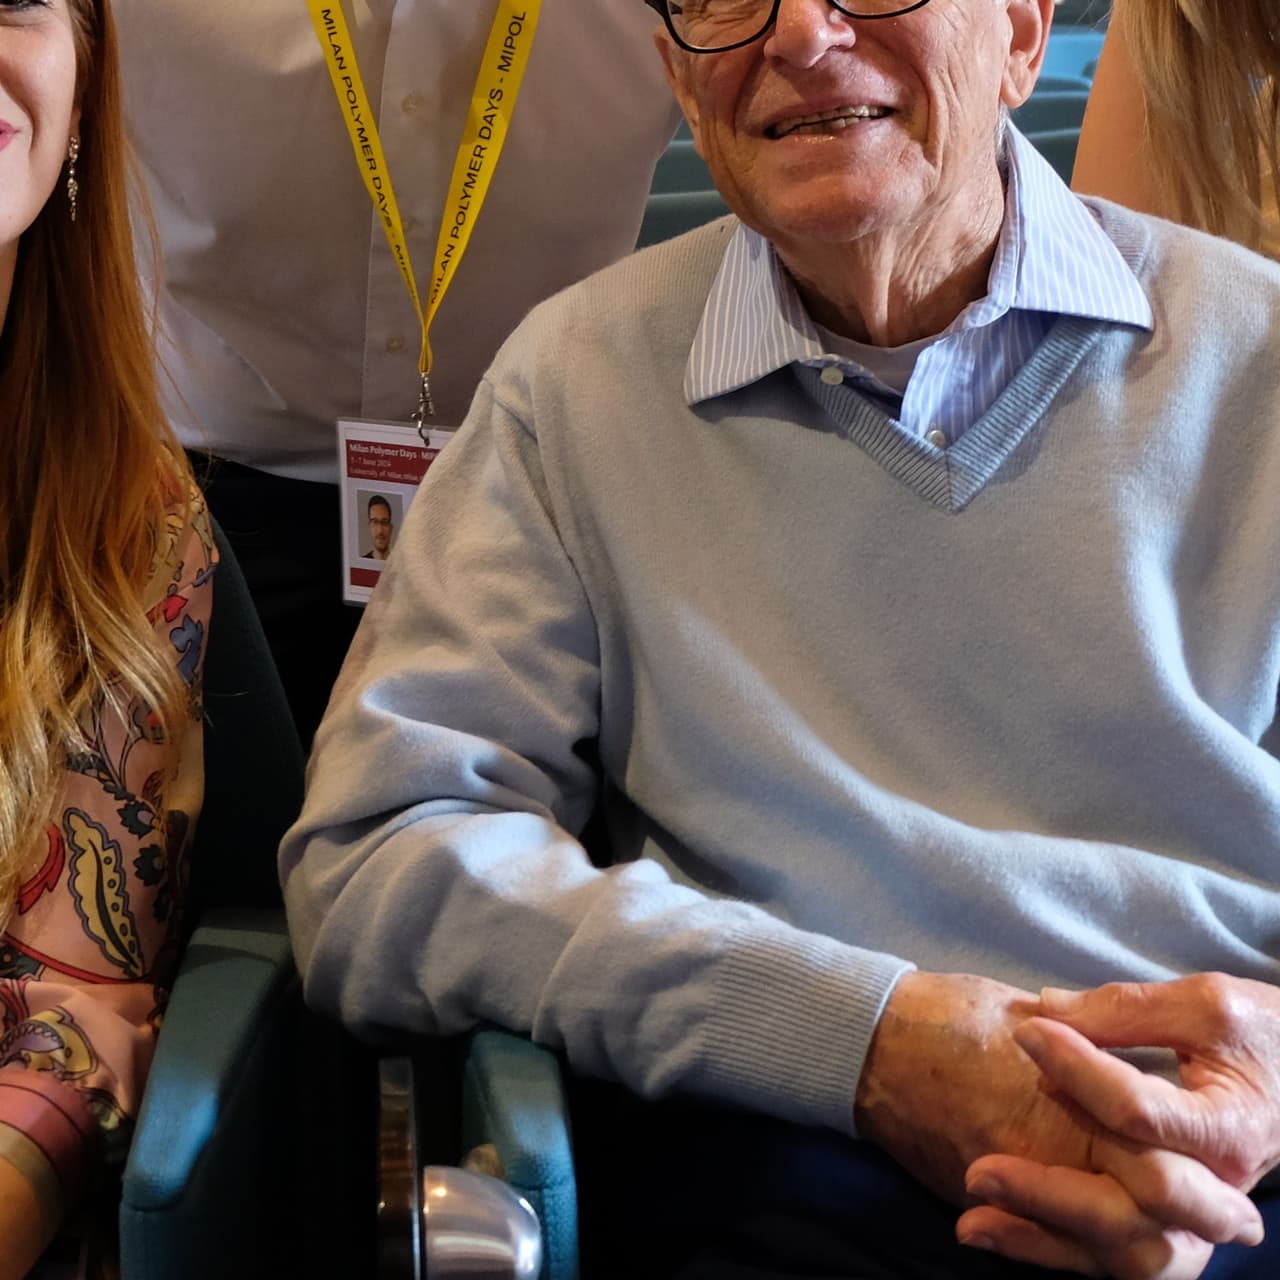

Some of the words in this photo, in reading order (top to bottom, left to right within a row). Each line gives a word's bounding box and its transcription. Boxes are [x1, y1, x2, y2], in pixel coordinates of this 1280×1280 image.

[321, 8, 347, 71] MILAN
[342, 76, 377, 171] POLYMER
[372, 176, 393, 228] DAYS
[431, 244, 455, 304] MILAN
[450, 144, 487, 240] POLYMER
[478, 88, 503, 140] DAYS
[497, 11, 526, 72] MIPOL
[349, 444, 369, 453] Milan
[370, 446, 399, 457] Polymer
[400, 449, 417, 460] Days
